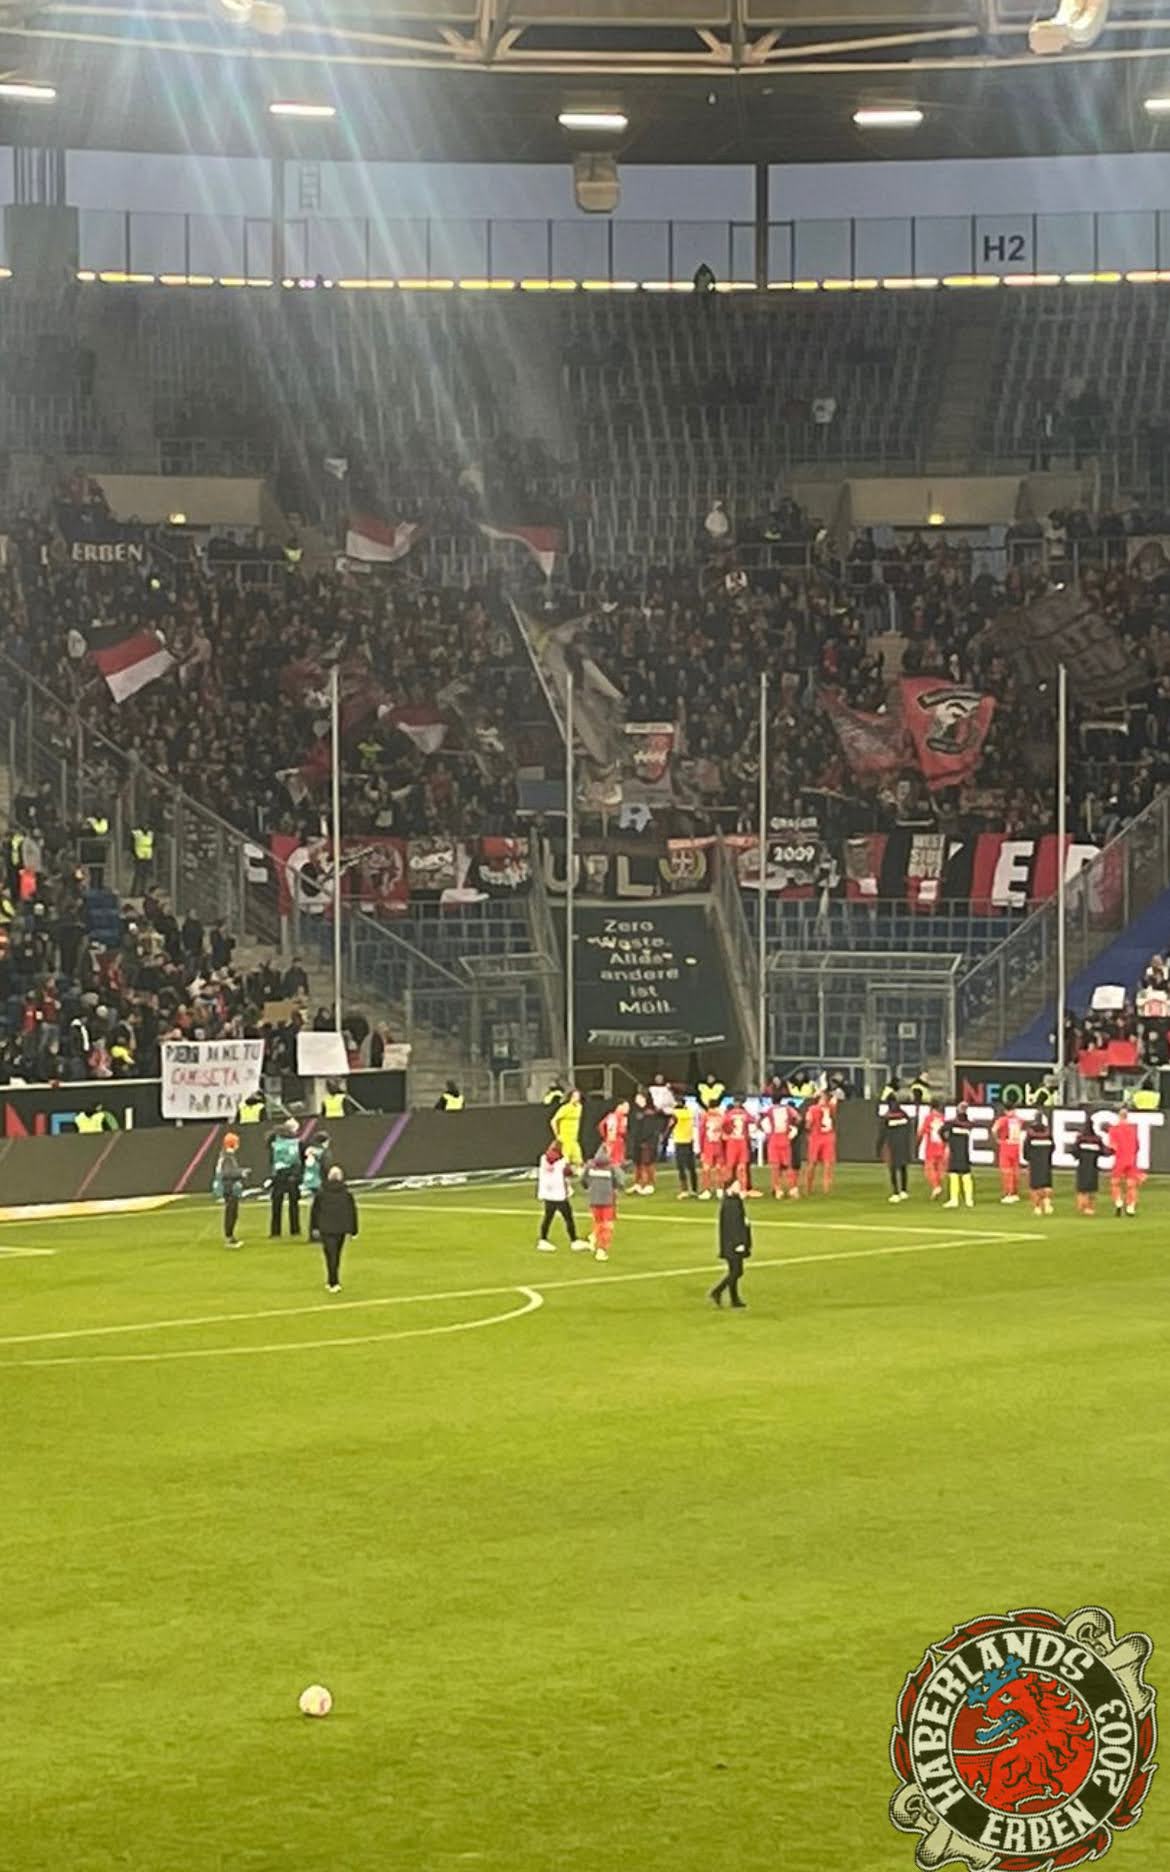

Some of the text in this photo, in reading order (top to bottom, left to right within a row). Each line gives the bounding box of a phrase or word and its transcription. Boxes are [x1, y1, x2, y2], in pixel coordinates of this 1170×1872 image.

[983, 233, 1025, 261] H2
[71, 542, 144, 562] ERBEN
[774, 845, 815, 863] 2009
[603, 919, 655, 933] Zero
[600, 968, 680, 981] andere
[630, 985, 659, 998] ist
[243, 1043, 260, 1061] TU
